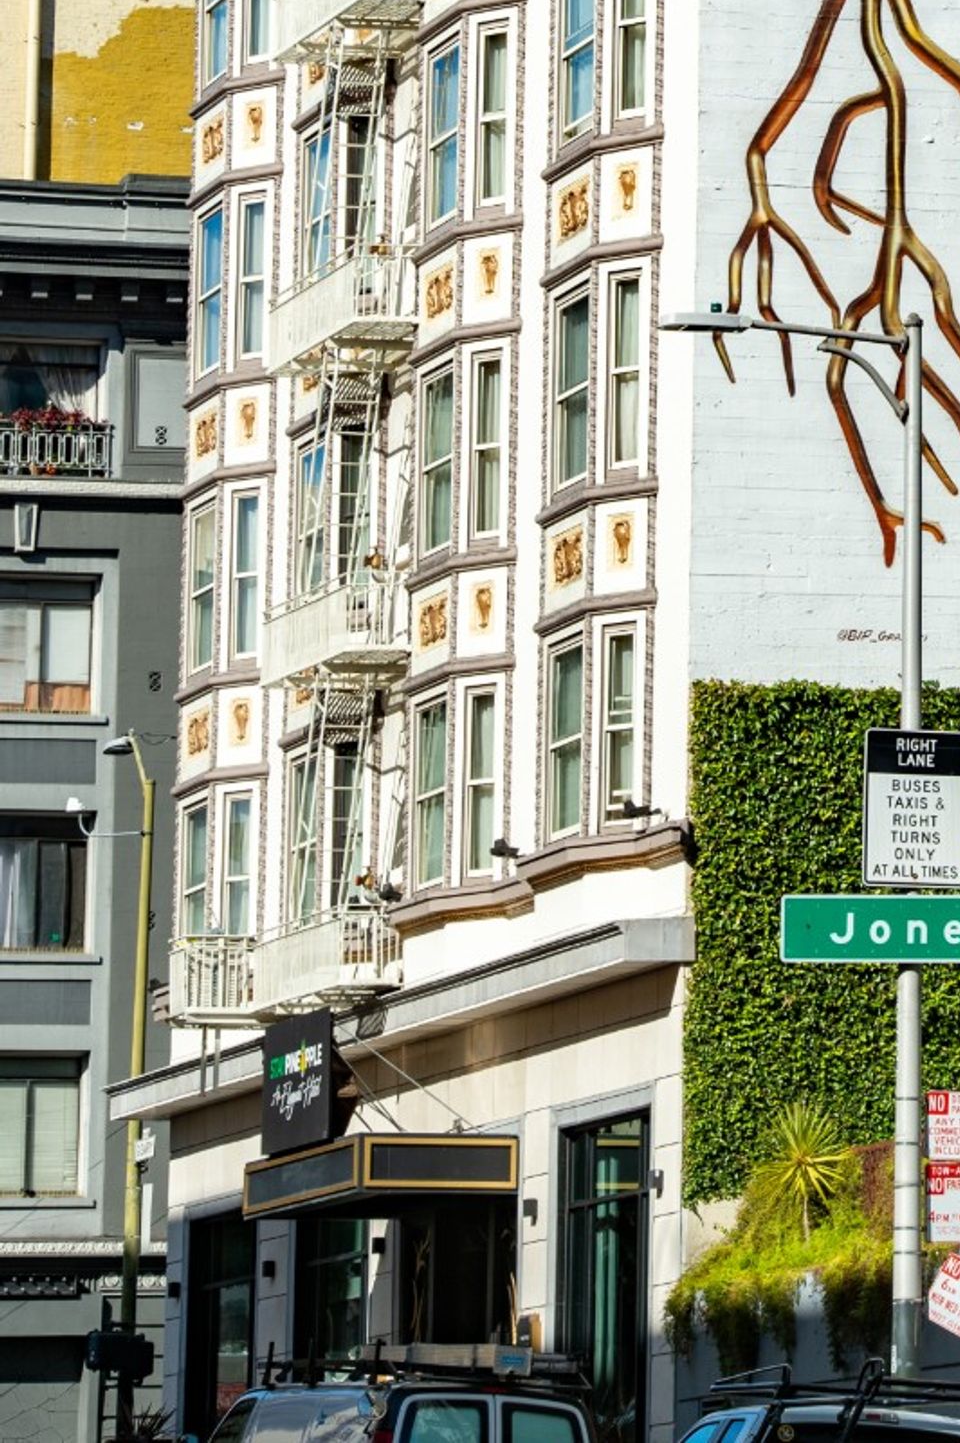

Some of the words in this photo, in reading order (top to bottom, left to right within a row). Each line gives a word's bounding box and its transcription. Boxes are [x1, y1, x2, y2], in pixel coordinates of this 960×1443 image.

[896, 738, 938, 753] RIGHT
[898, 753, 935, 768] LANE
[891, 779, 941, 793] BUSES
[887, 795, 928, 809] TAXIS
[935, 797, 945, 810] &
[892, 813, 938, 828] RIGHT
[891, 831, 941, 845] TURNS
[894, 847, 936, 862] ONLY
[872, 863, 888, 877] AT
[892, 864, 918, 878] ALL
[921, 865, 959, 879] TIMES
[928, 1094, 946, 1112] NO
[928, 1178, 943, 1193] NO
